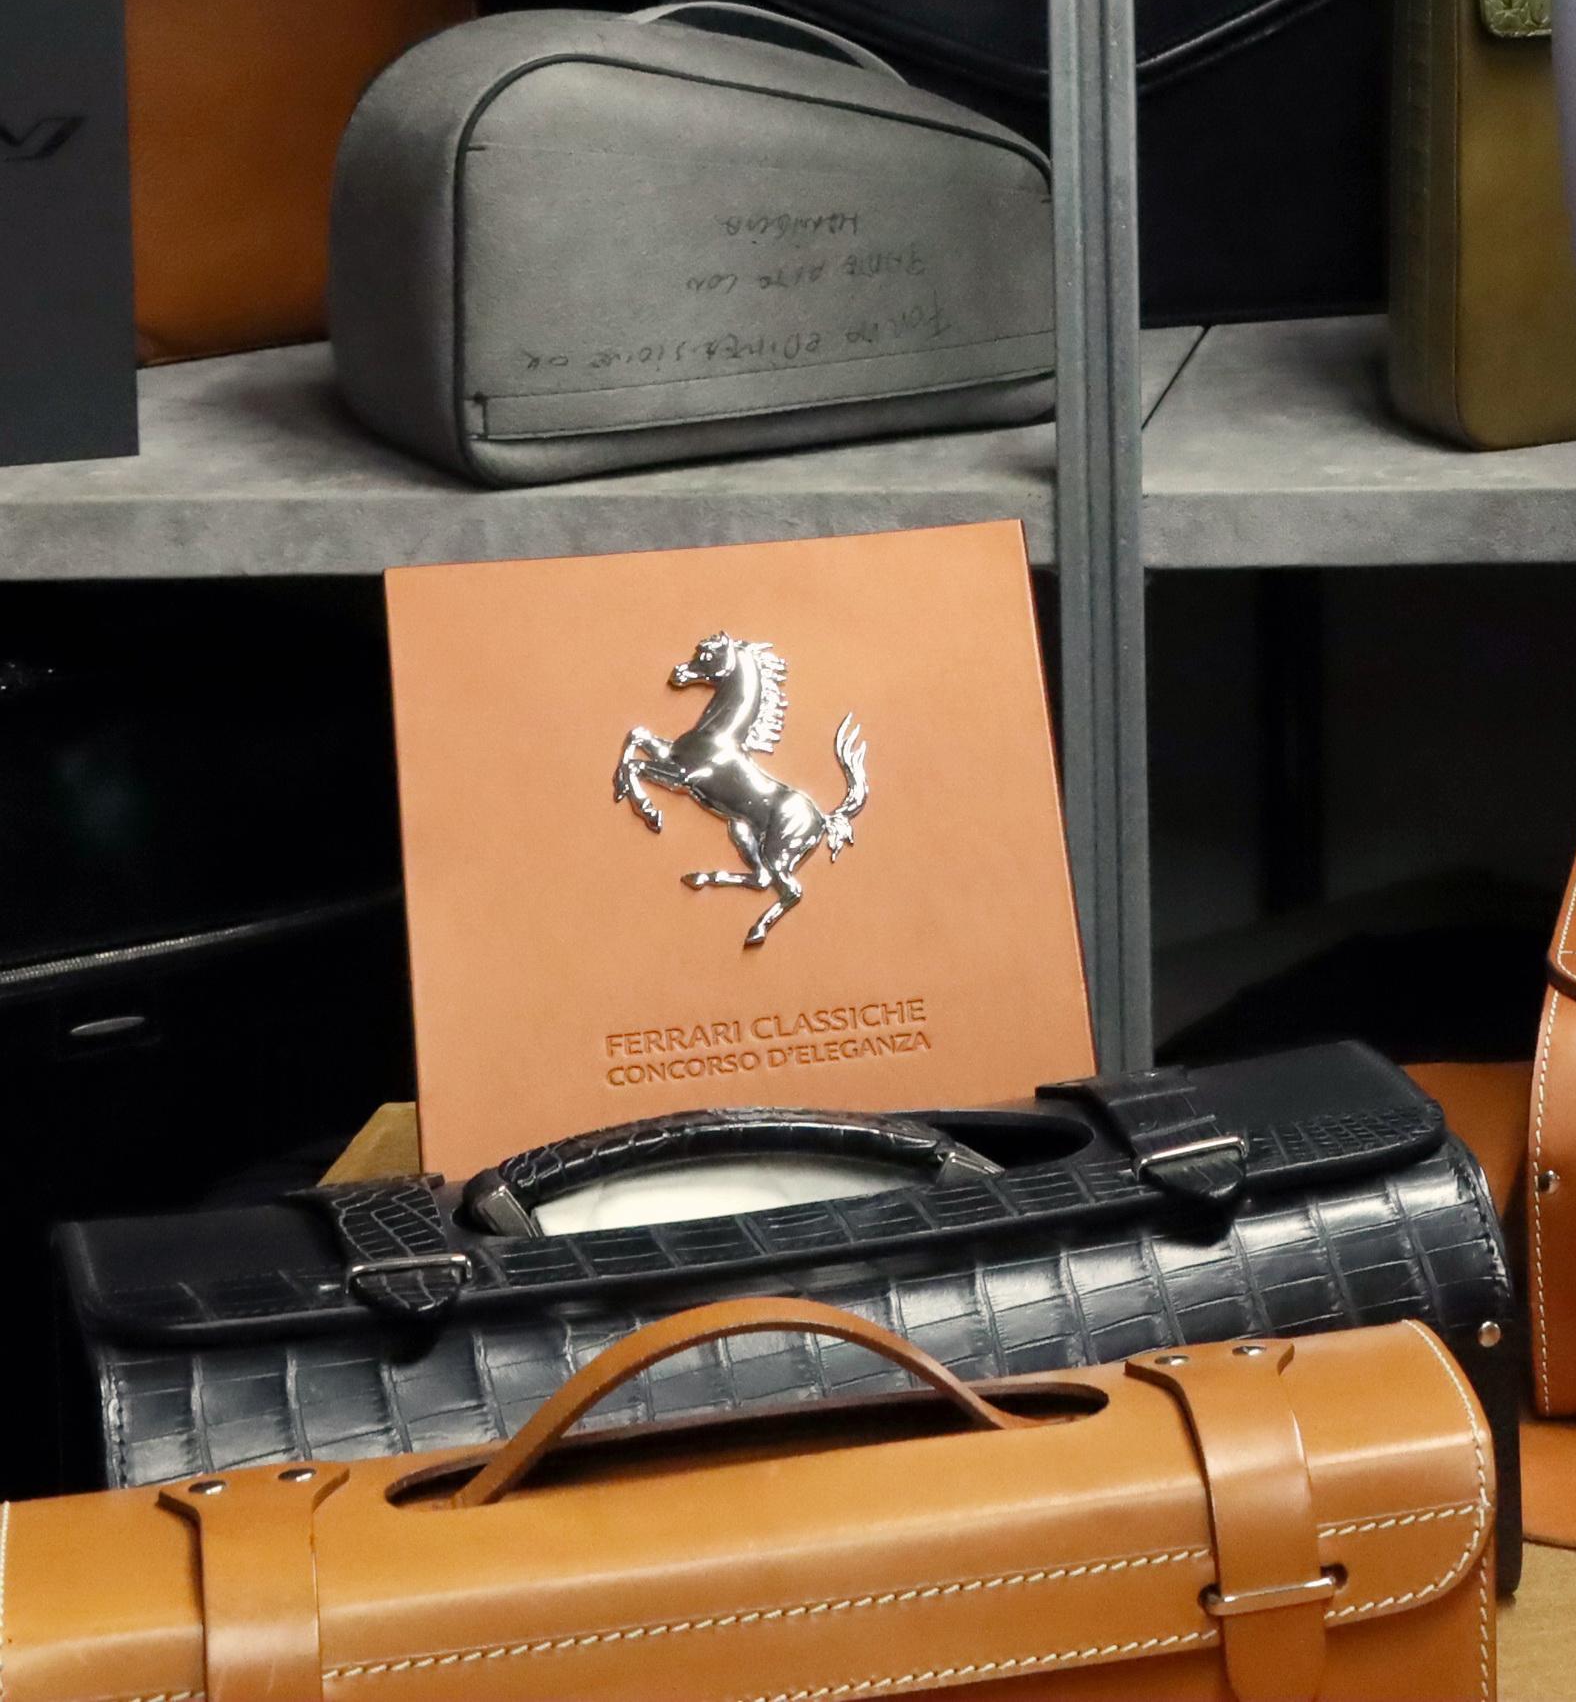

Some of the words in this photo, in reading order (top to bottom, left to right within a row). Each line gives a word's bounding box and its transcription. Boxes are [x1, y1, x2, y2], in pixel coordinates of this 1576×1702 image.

[605, 1020, 741, 1058] FERRARI
[752, 998, 928, 1040] CLASSICHE
[605, 1051, 760, 1088] CONCORSO
[768, 1030, 931, 1069] D'ELEGANZA
